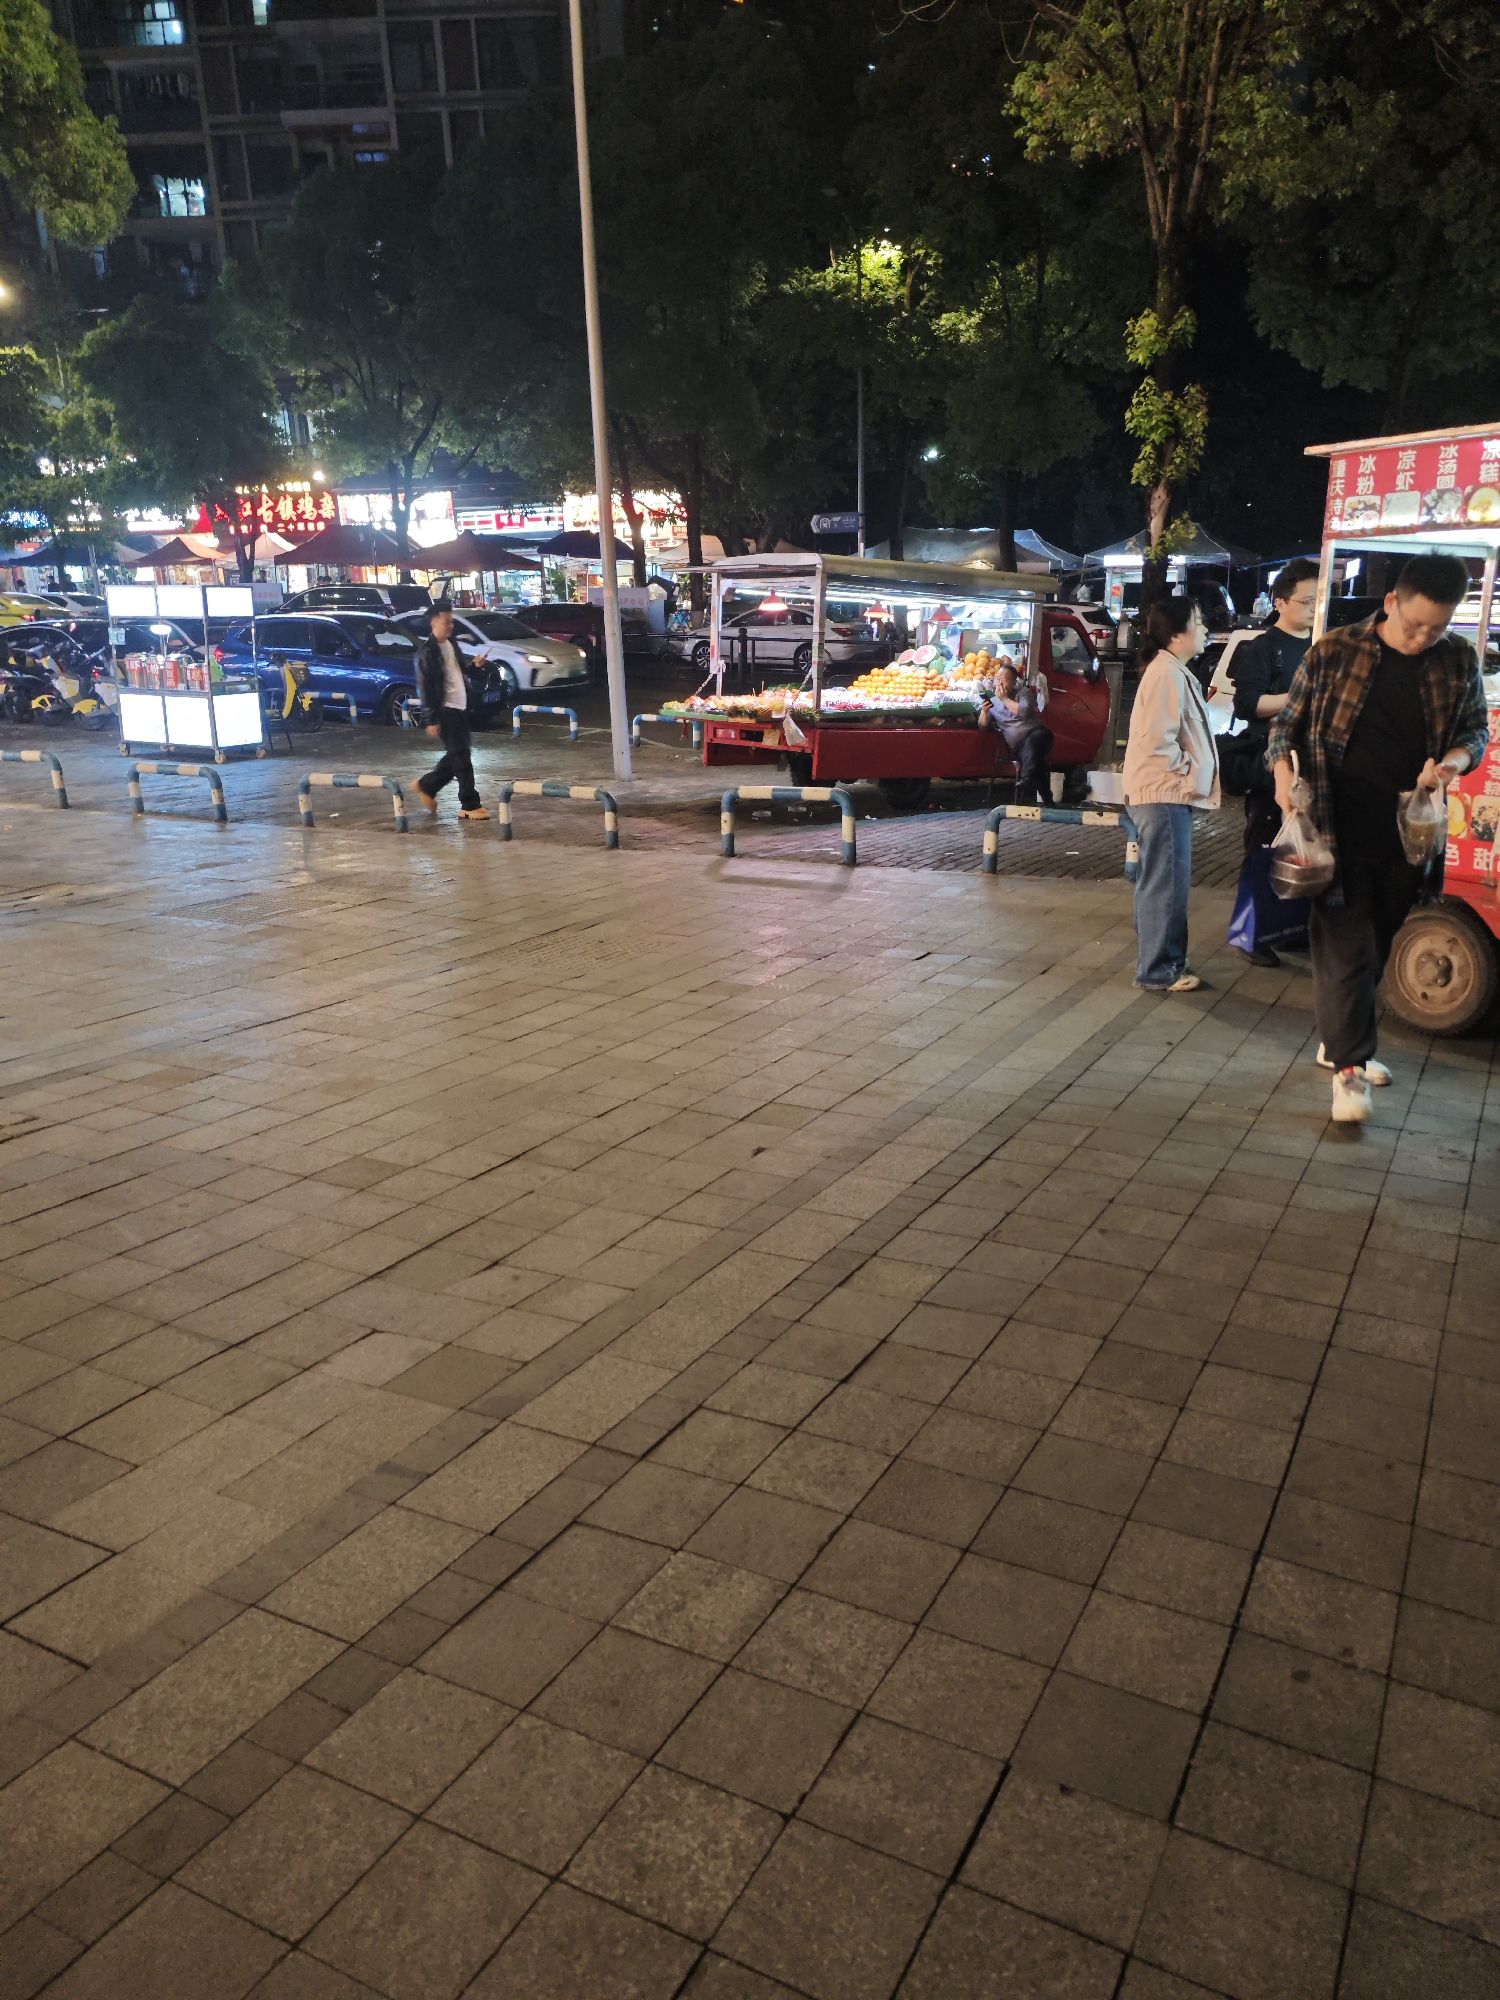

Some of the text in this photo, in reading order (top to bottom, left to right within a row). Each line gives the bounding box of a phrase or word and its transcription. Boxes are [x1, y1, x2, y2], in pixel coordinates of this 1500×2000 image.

[1356, 454, 1377, 495] 冰粉
[1396, 450, 1417, 491] 凉虾
[1437, 444, 1459, 489] 冰汤圆
[1327, 459, 1347, 533] 重庆特色
[1473, 847, 1500, 872] 甜
